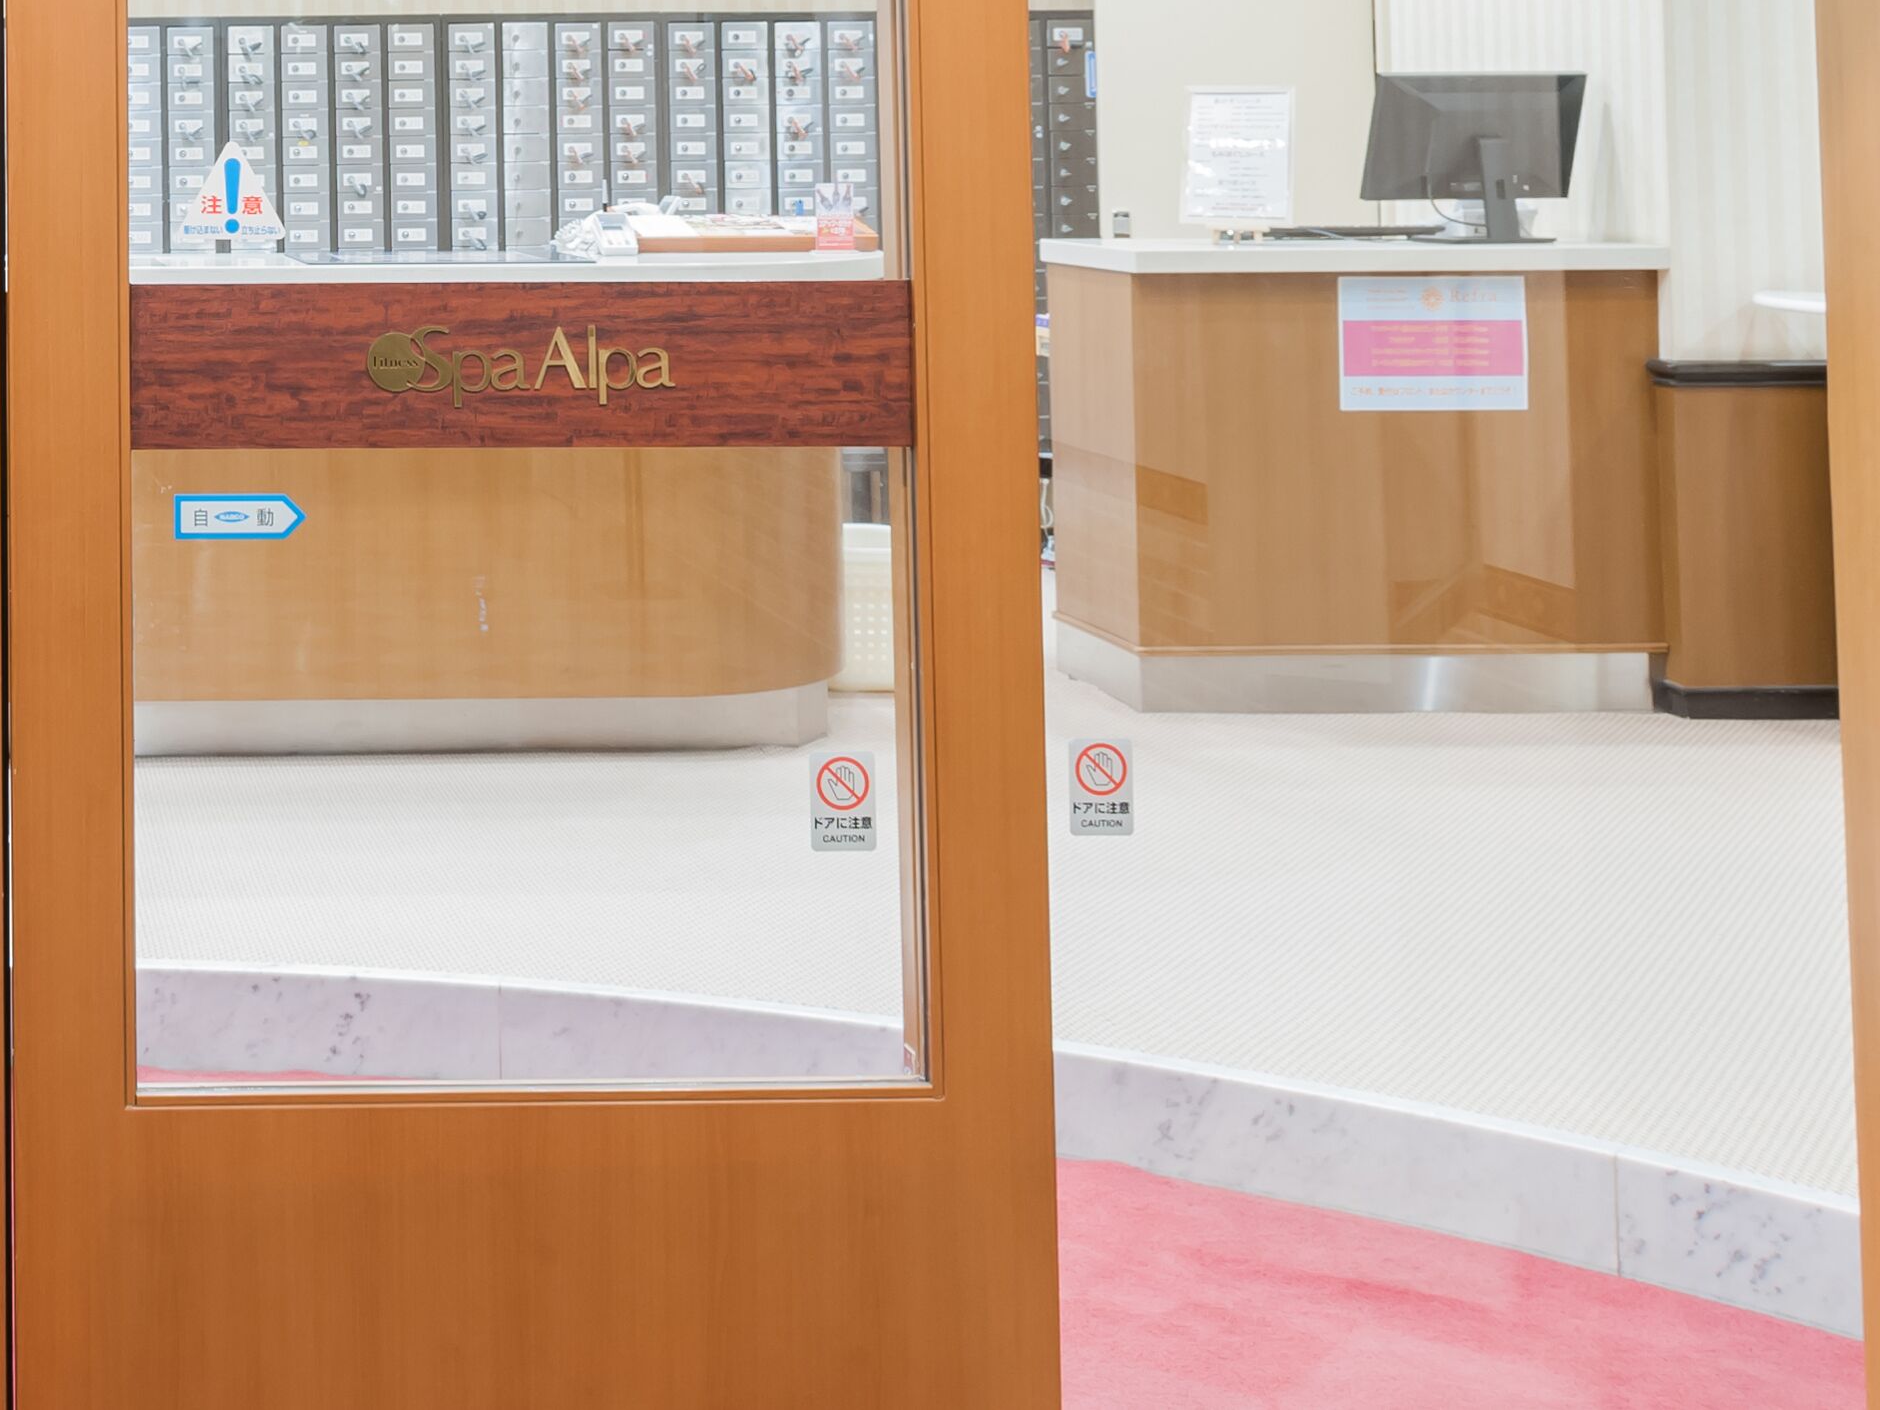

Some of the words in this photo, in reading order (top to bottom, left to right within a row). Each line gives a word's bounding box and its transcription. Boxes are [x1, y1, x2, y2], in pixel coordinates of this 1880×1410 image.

[373, 356, 419, 369] Fitness
[407, 326, 531, 409] Spa
[534, 325, 676, 406] Alpa
[1072, 801, 1130, 815] ドアに注意
[814, 816, 873, 830] ドアに注意
[1081, 819, 1123, 828] CAUTION
[823, 834, 865, 843] CAUTION
